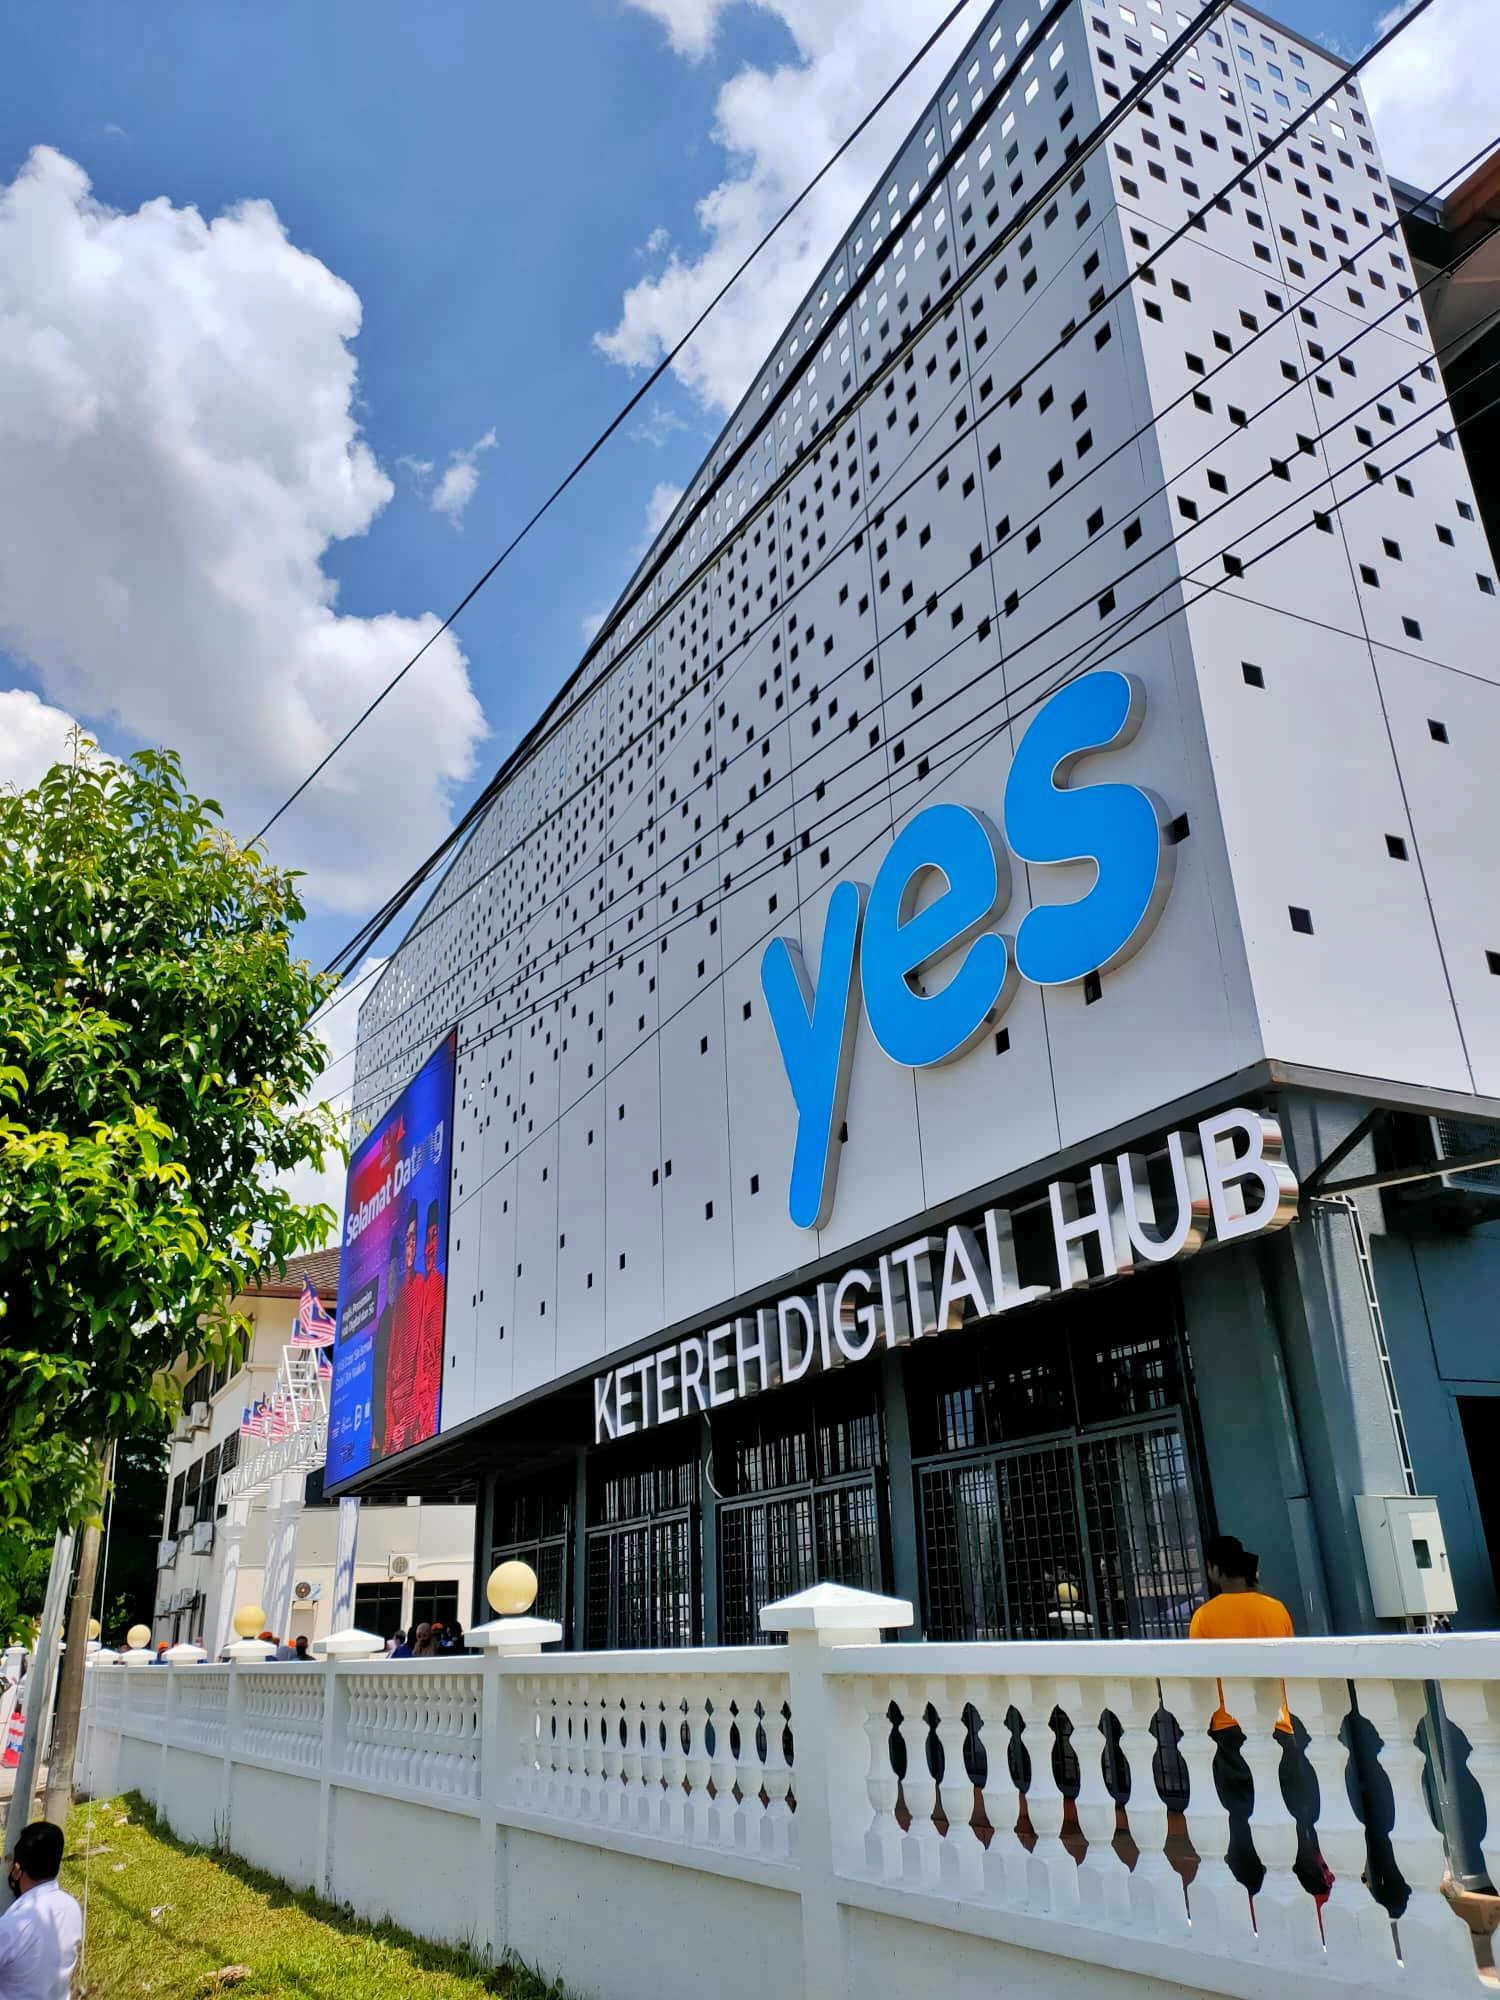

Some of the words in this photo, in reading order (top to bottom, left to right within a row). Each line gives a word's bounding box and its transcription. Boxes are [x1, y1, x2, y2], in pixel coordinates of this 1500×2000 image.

[761, 670, 1168, 1230] yes
[345, 1173, 392, 1248] Selamat
[393, 1119, 444, 1198] Datag
[594, 1308, 774, 1445] KETEREH
[777, 1209, 1045, 1385] DIGITAL
[1048, 1107, 1290, 1291] HUB
